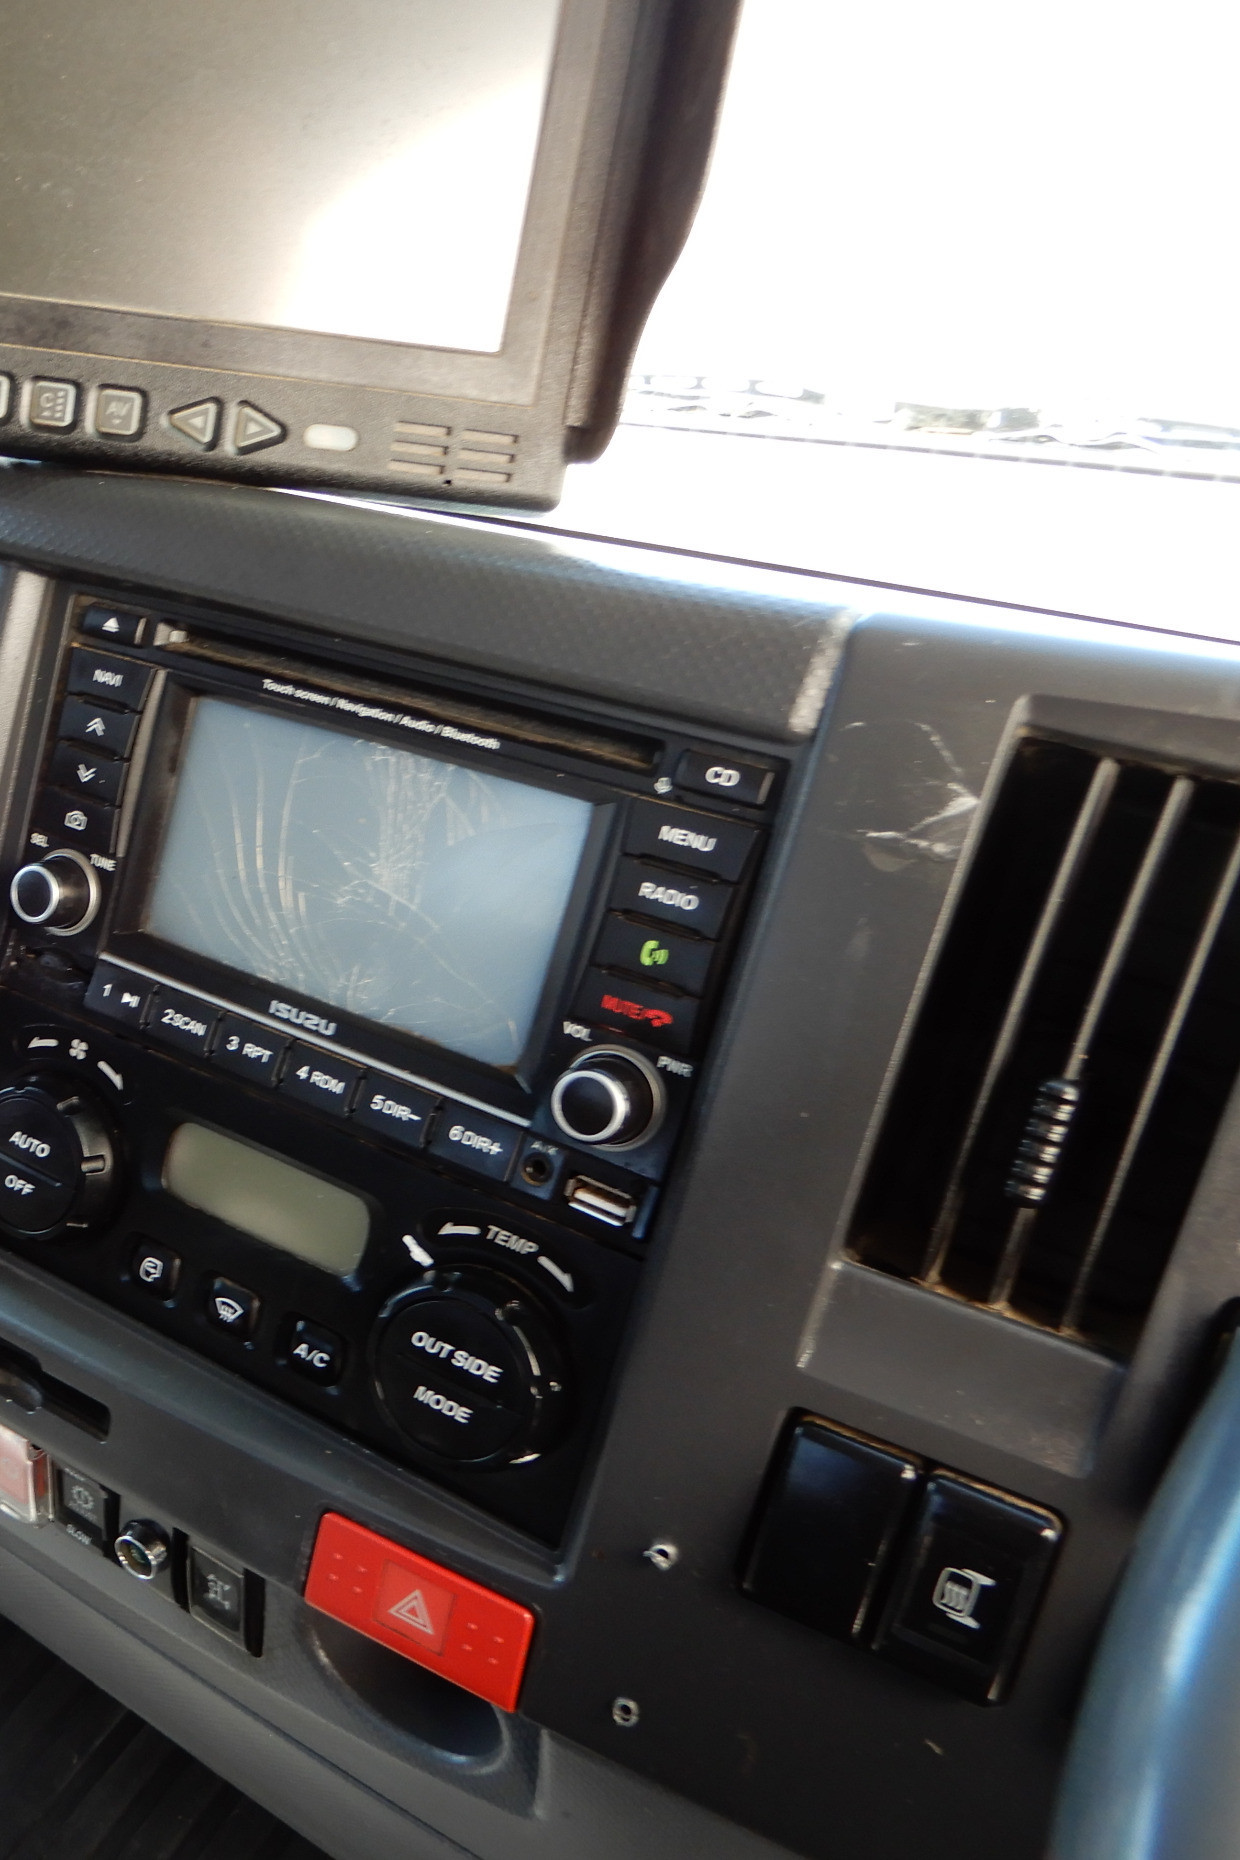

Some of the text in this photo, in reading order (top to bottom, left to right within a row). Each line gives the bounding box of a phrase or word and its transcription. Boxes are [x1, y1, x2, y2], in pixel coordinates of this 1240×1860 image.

[93, 669, 123, 687] NAVI
[705, 766, 740, 786] CD
[658, 826, 717, 851] MENU
[90, 853, 117, 871] TUNE
[638, 882, 699, 910] RADIO
[102, 984, 112, 997] 1
[268, 1000, 337, 1036] ISUZU
[563, 1021, 592, 1041] VOL
[226, 1036, 273, 1062] 3 RPT
[9, 1131, 51, 1158] AUTO
[4, 1174, 36, 1195] OFF
[485, 1225, 540, 1256] TEMP
[293, 1343, 331, 1369] A/C
[413, 1384, 474, 1424] MODE
